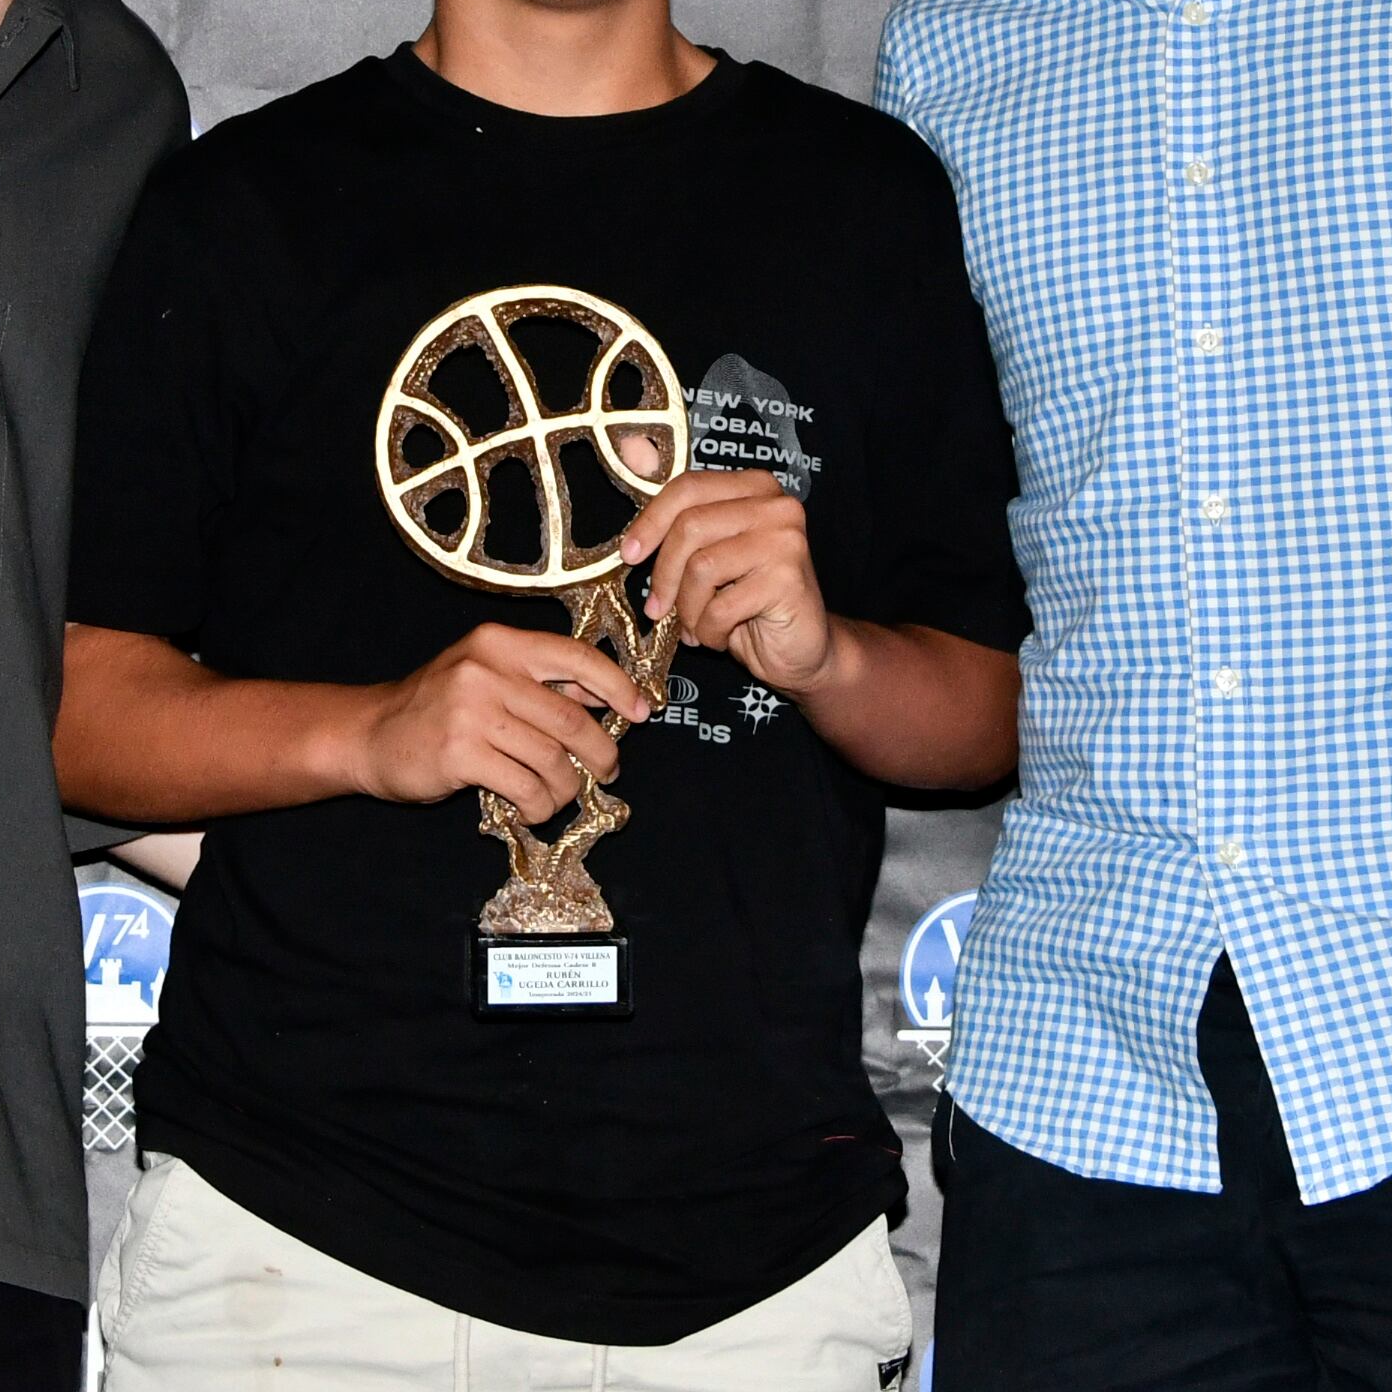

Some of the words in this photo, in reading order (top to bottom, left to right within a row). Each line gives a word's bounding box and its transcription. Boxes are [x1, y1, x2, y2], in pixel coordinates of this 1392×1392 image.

[682, 387, 741, 409] NEW
[753, 396, 815, 423] YORK
[689, 412, 779, 439] LOBAL
[493, 953, 513, 961] CLUB
[514, 952, 562, 961] BALONCESTO
[580, 952, 611, 960] VILLENA
[546, 969, 581, 979] RUBÉN
[519, 981, 554, 989] UGEDA
[557, 980, 609, 988] CARRILLO
